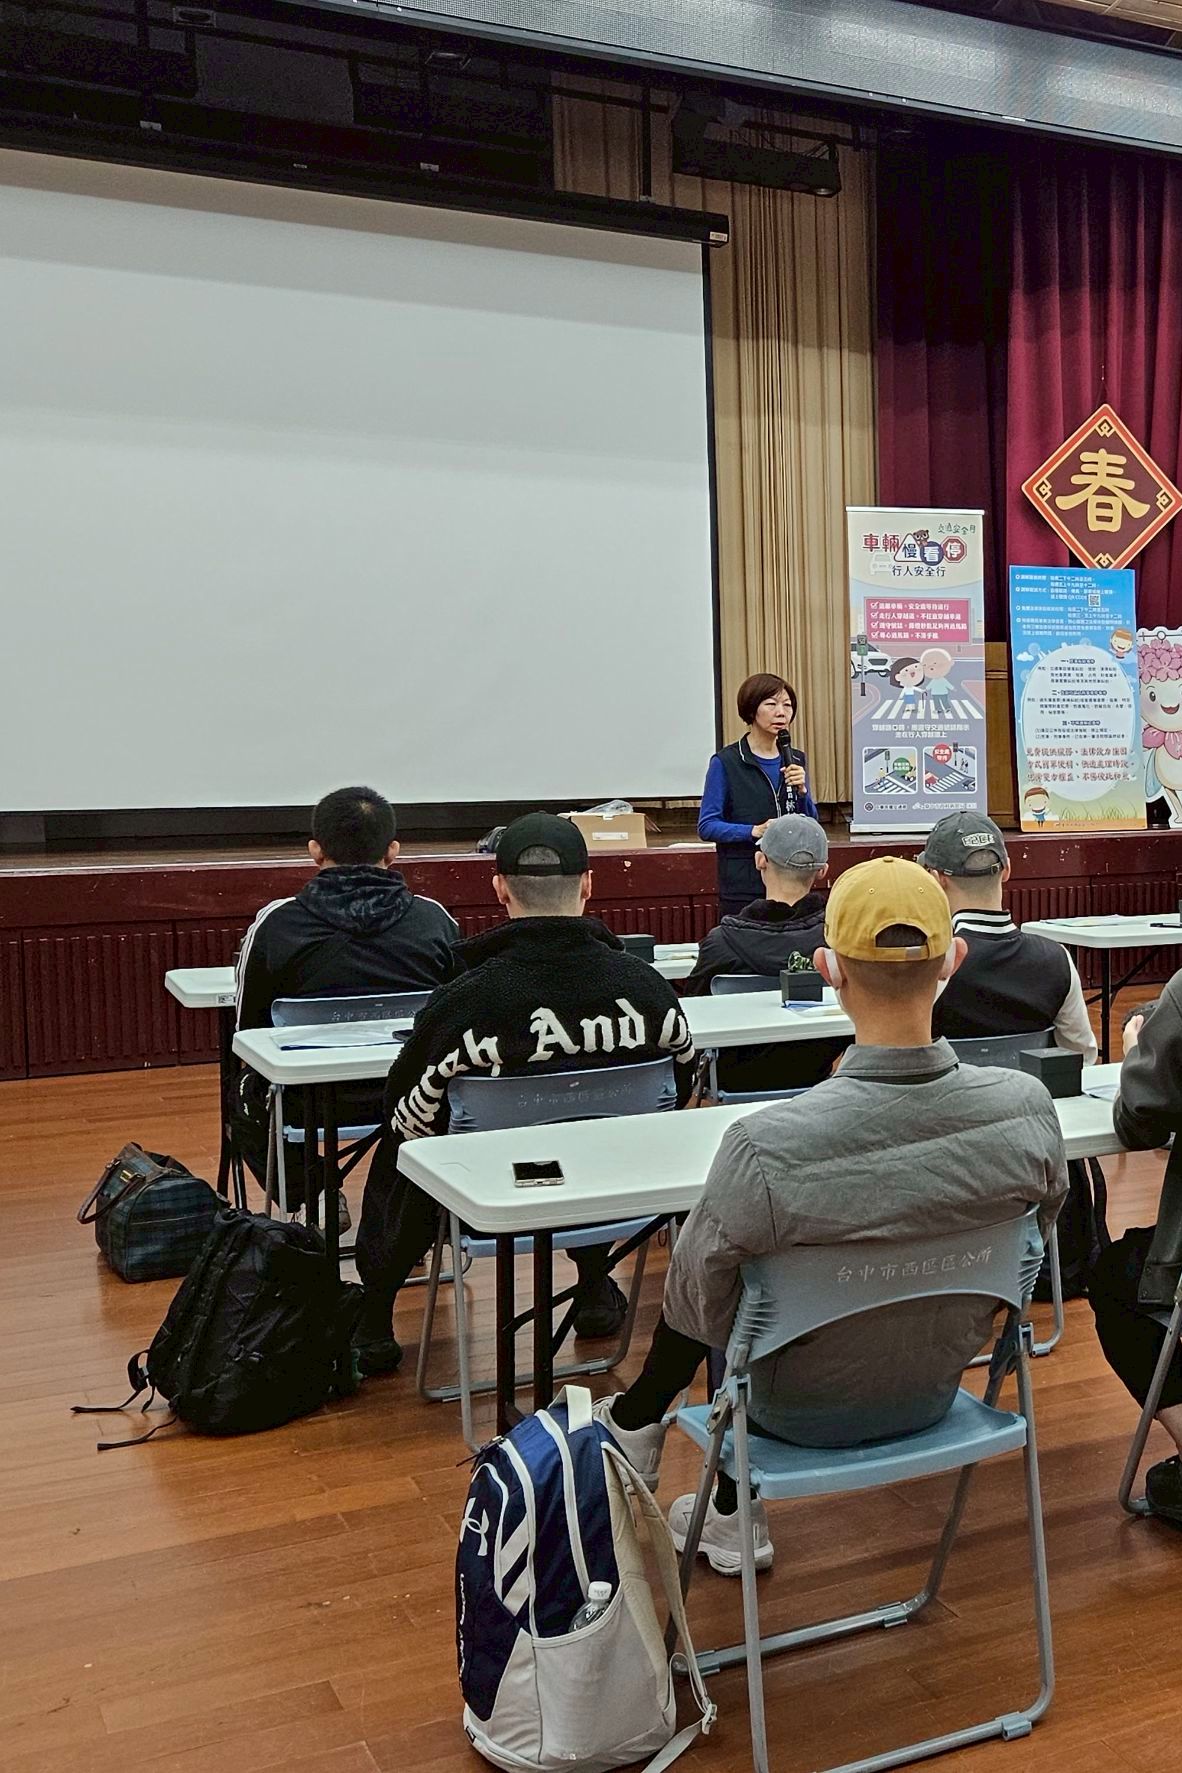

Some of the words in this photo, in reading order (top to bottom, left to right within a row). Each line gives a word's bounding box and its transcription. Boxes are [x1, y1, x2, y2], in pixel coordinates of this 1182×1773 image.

[1055, 448, 1150, 533] 春
[892, 565, 946, 577] 行人安全行
[527, 998, 646, 1063] And
